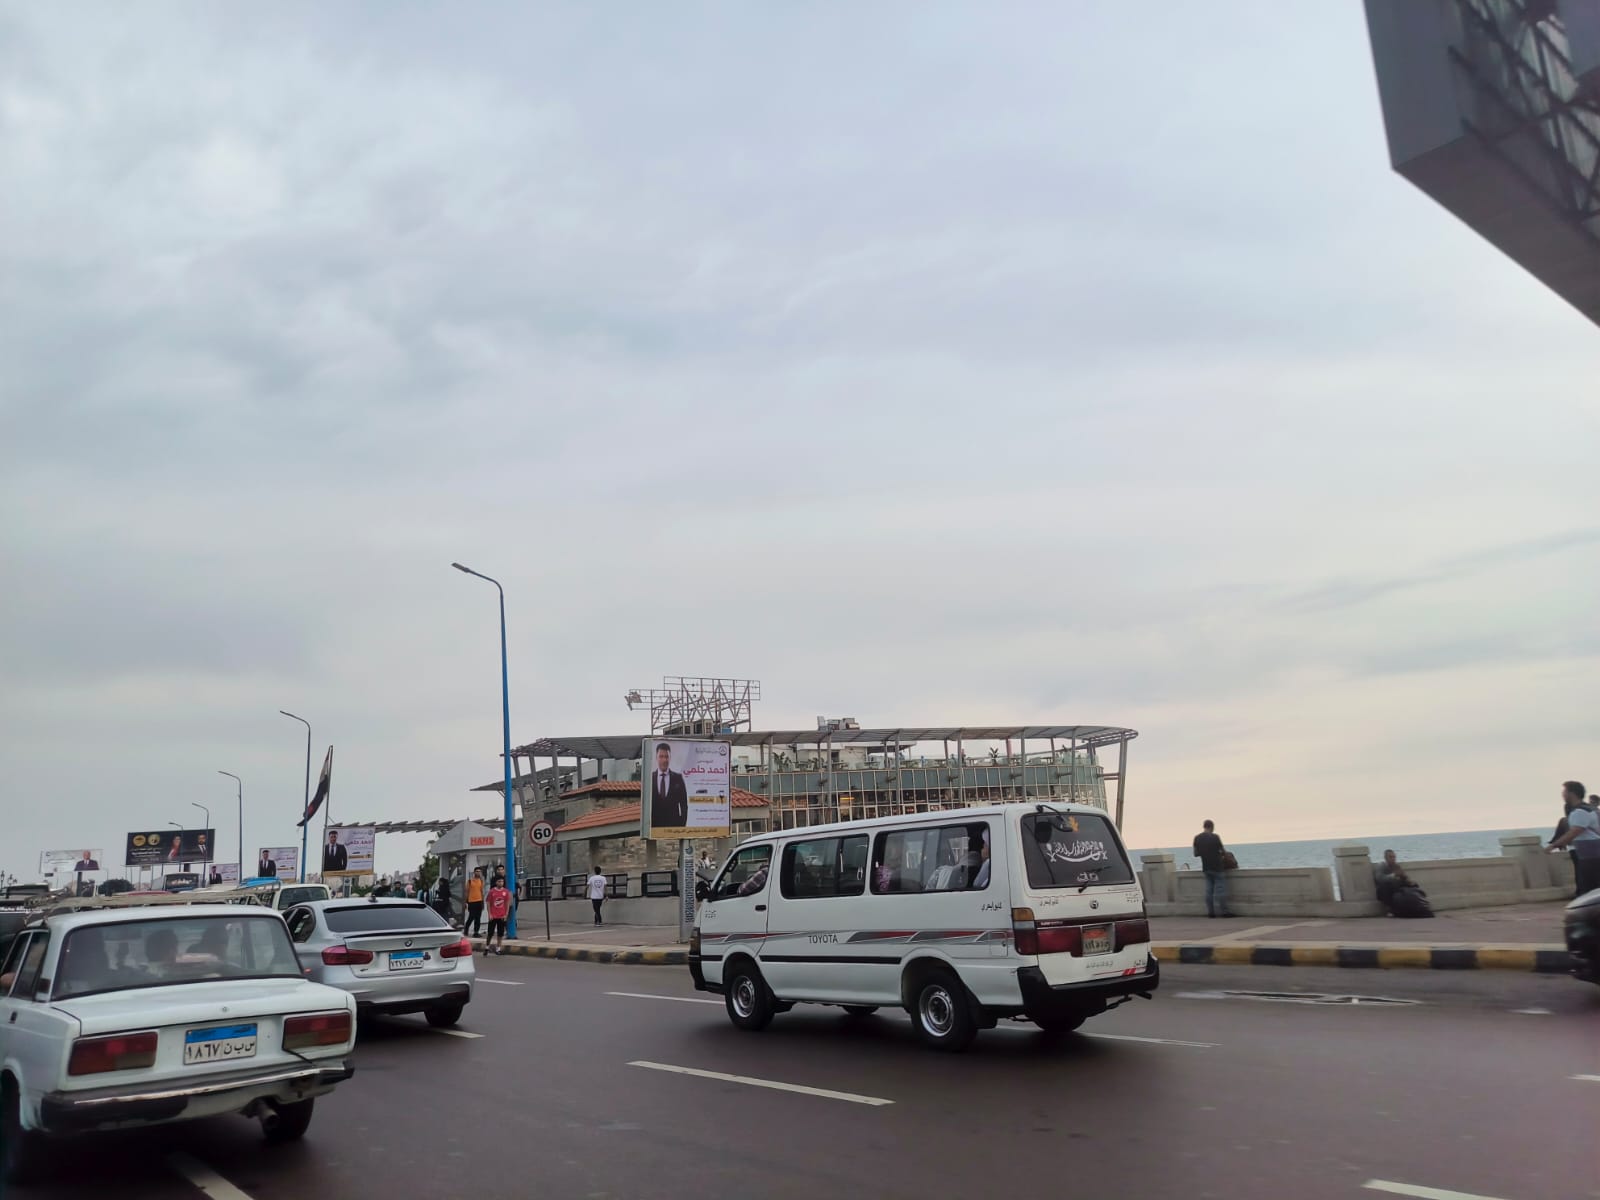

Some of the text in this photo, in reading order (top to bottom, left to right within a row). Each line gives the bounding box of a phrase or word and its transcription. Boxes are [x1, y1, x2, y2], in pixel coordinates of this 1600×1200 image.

[683, 763, 727, 777] أحمد حلمي
[534, 828, 551, 840] 60
[808, 934, 839, 944] TOYOTA
[187, 1043, 220, 1060] ١٨٦٧
